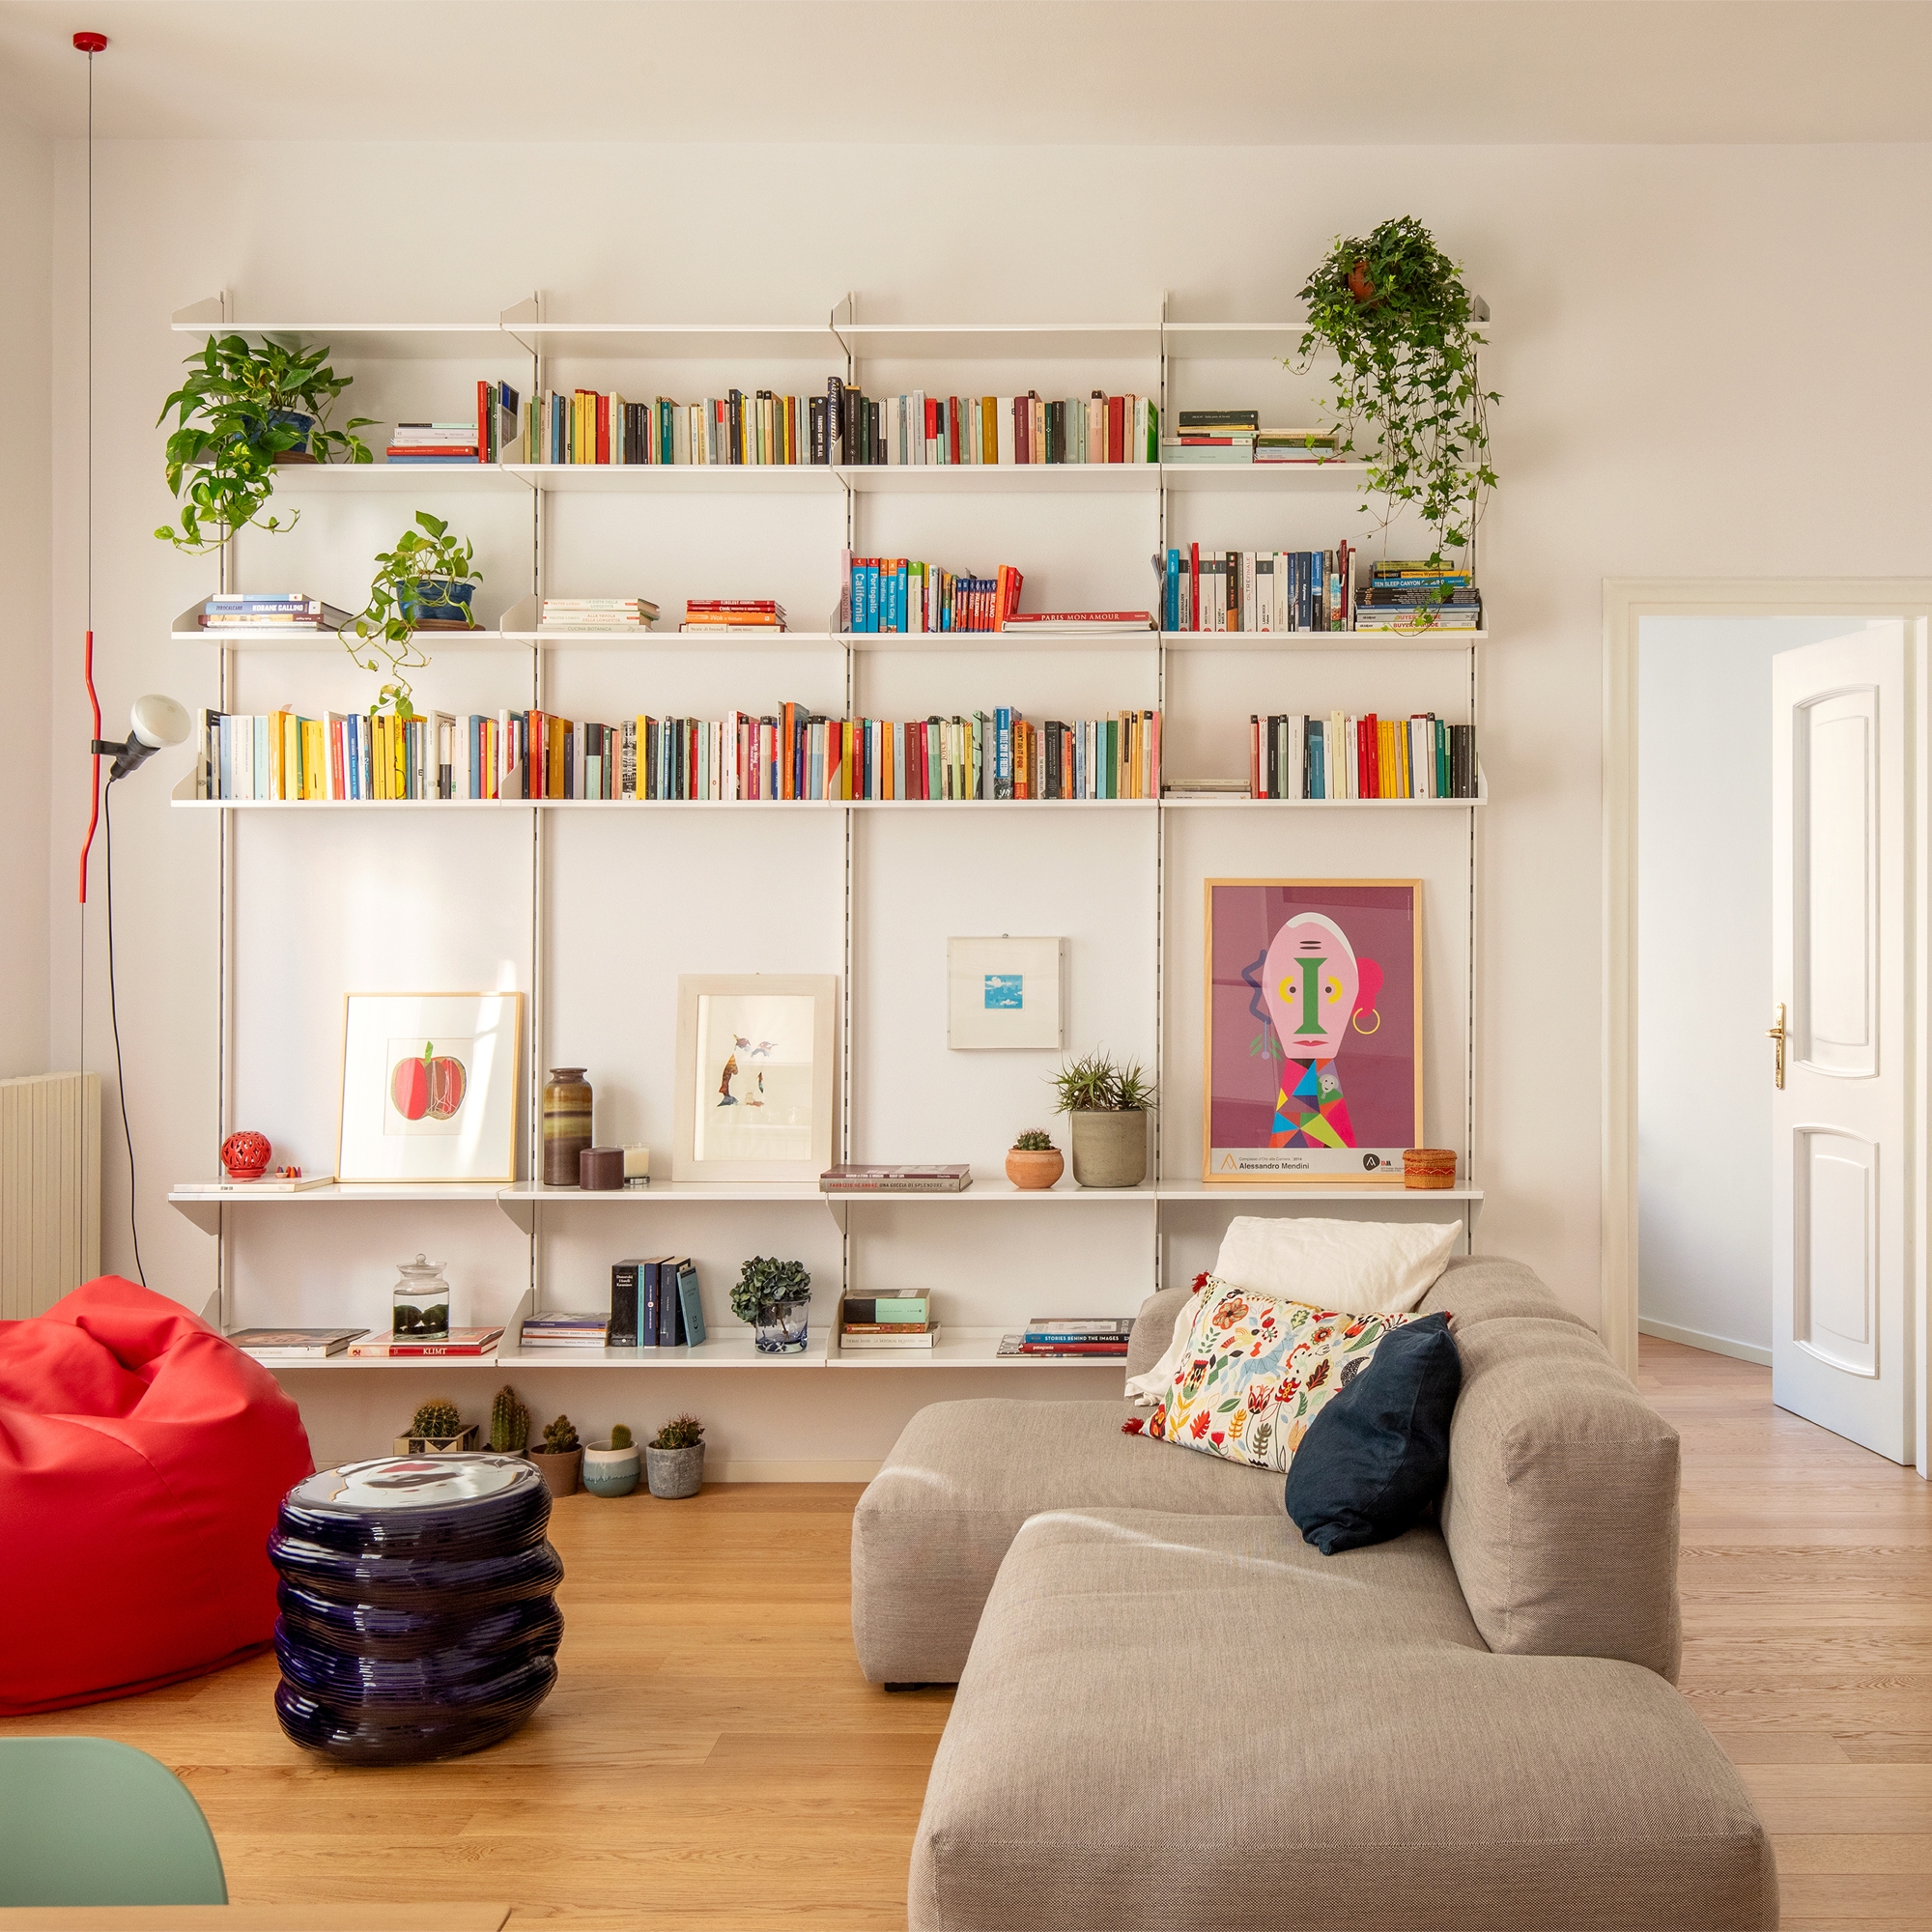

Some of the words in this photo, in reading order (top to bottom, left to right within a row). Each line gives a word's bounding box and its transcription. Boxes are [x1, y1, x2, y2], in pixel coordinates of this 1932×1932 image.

[855, 573, 864, 623] California
[868, 573, 877, 613] Portogallo
[1000, 730, 1008, 743] BATTLE
[1000, 758, 1008, 776] FREEDOM
